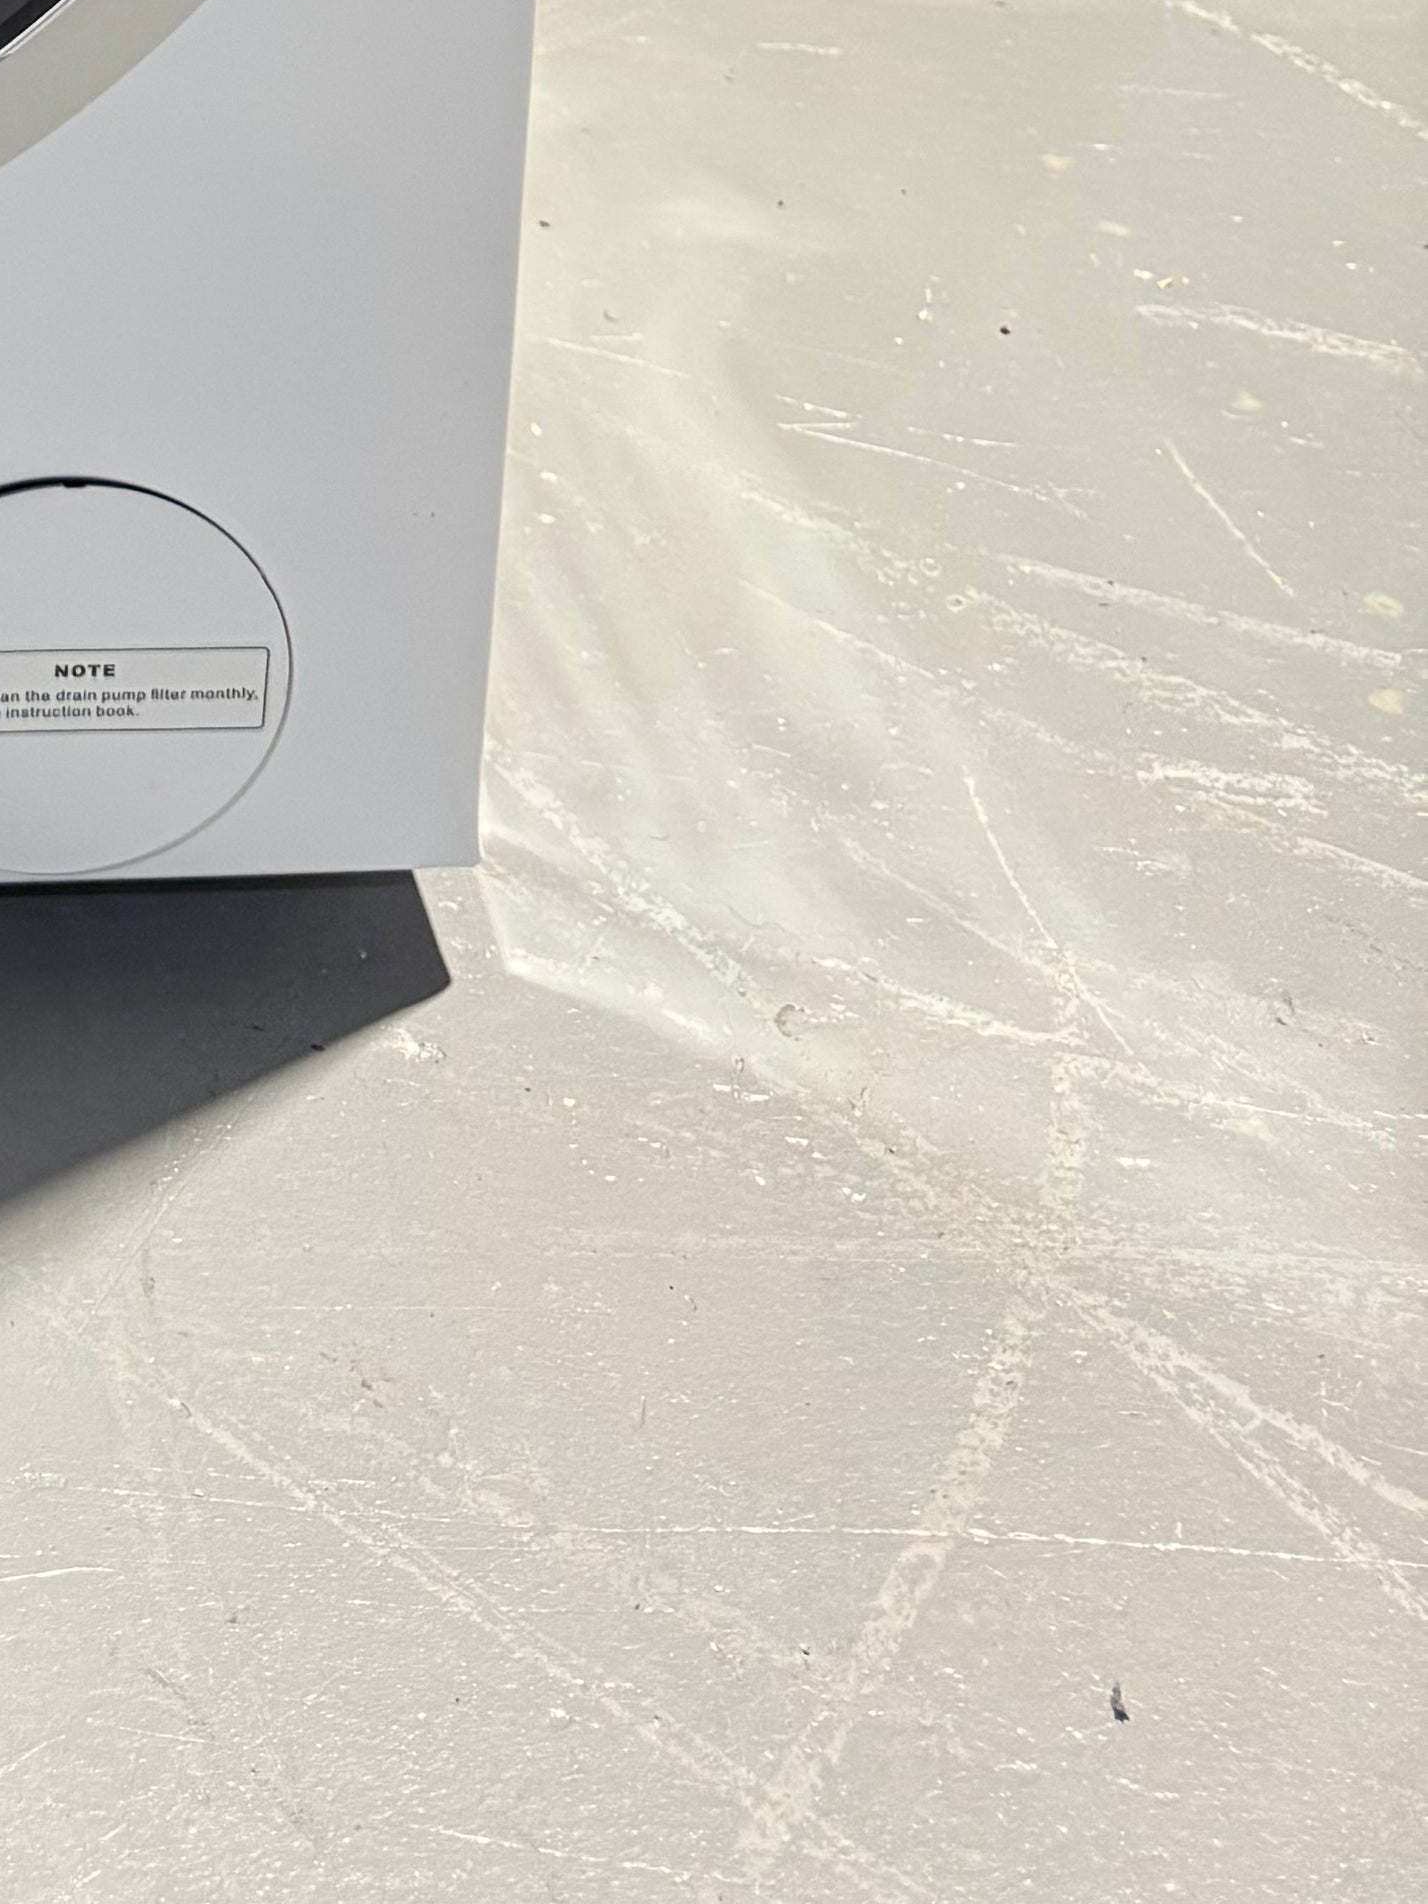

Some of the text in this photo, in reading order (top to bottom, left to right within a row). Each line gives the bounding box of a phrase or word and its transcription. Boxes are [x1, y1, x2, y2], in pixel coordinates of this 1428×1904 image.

[55, 664, 116, 678] NOTE
[25, 690, 50, 702] the
[56, 689, 97, 702] drain
[101, 690, 145, 704] pump
[150, 688, 186, 700] filter
[5, 705, 92, 719] instruction
[96, 704, 140, 718] book.
